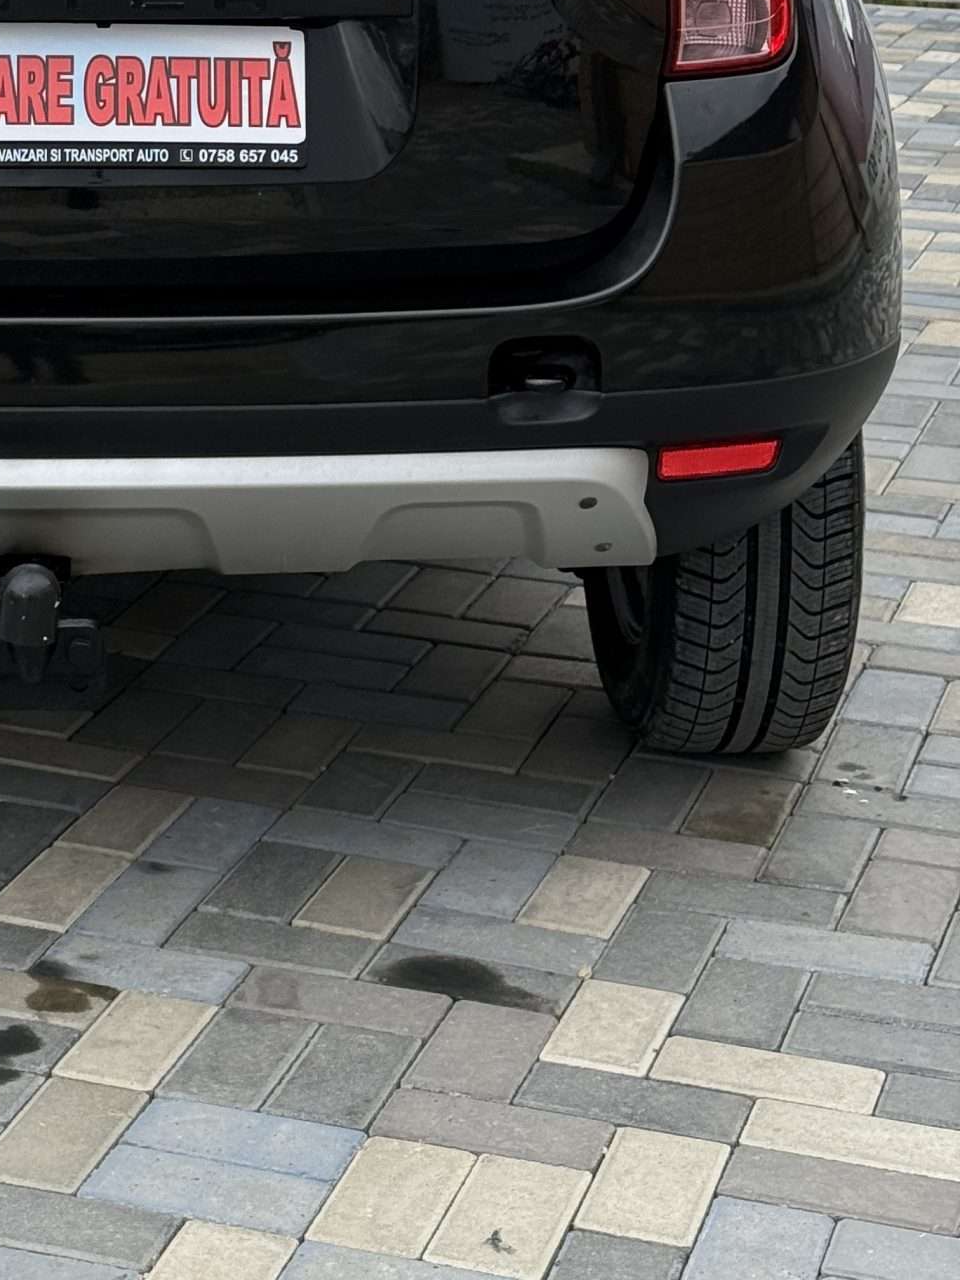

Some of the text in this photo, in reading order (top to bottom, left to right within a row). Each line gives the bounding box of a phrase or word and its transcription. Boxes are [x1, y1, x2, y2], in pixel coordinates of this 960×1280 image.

[84, 41, 302, 129] GRATUITĂ
[50, 149, 62, 162] SI
[64, 149, 135, 162] TRANSPORT
[136, 149, 170, 162] AUTO
[198, 149, 236, 163] 0758
[239, 149, 267, 163] 657
[270, 149, 299, 163] 045
